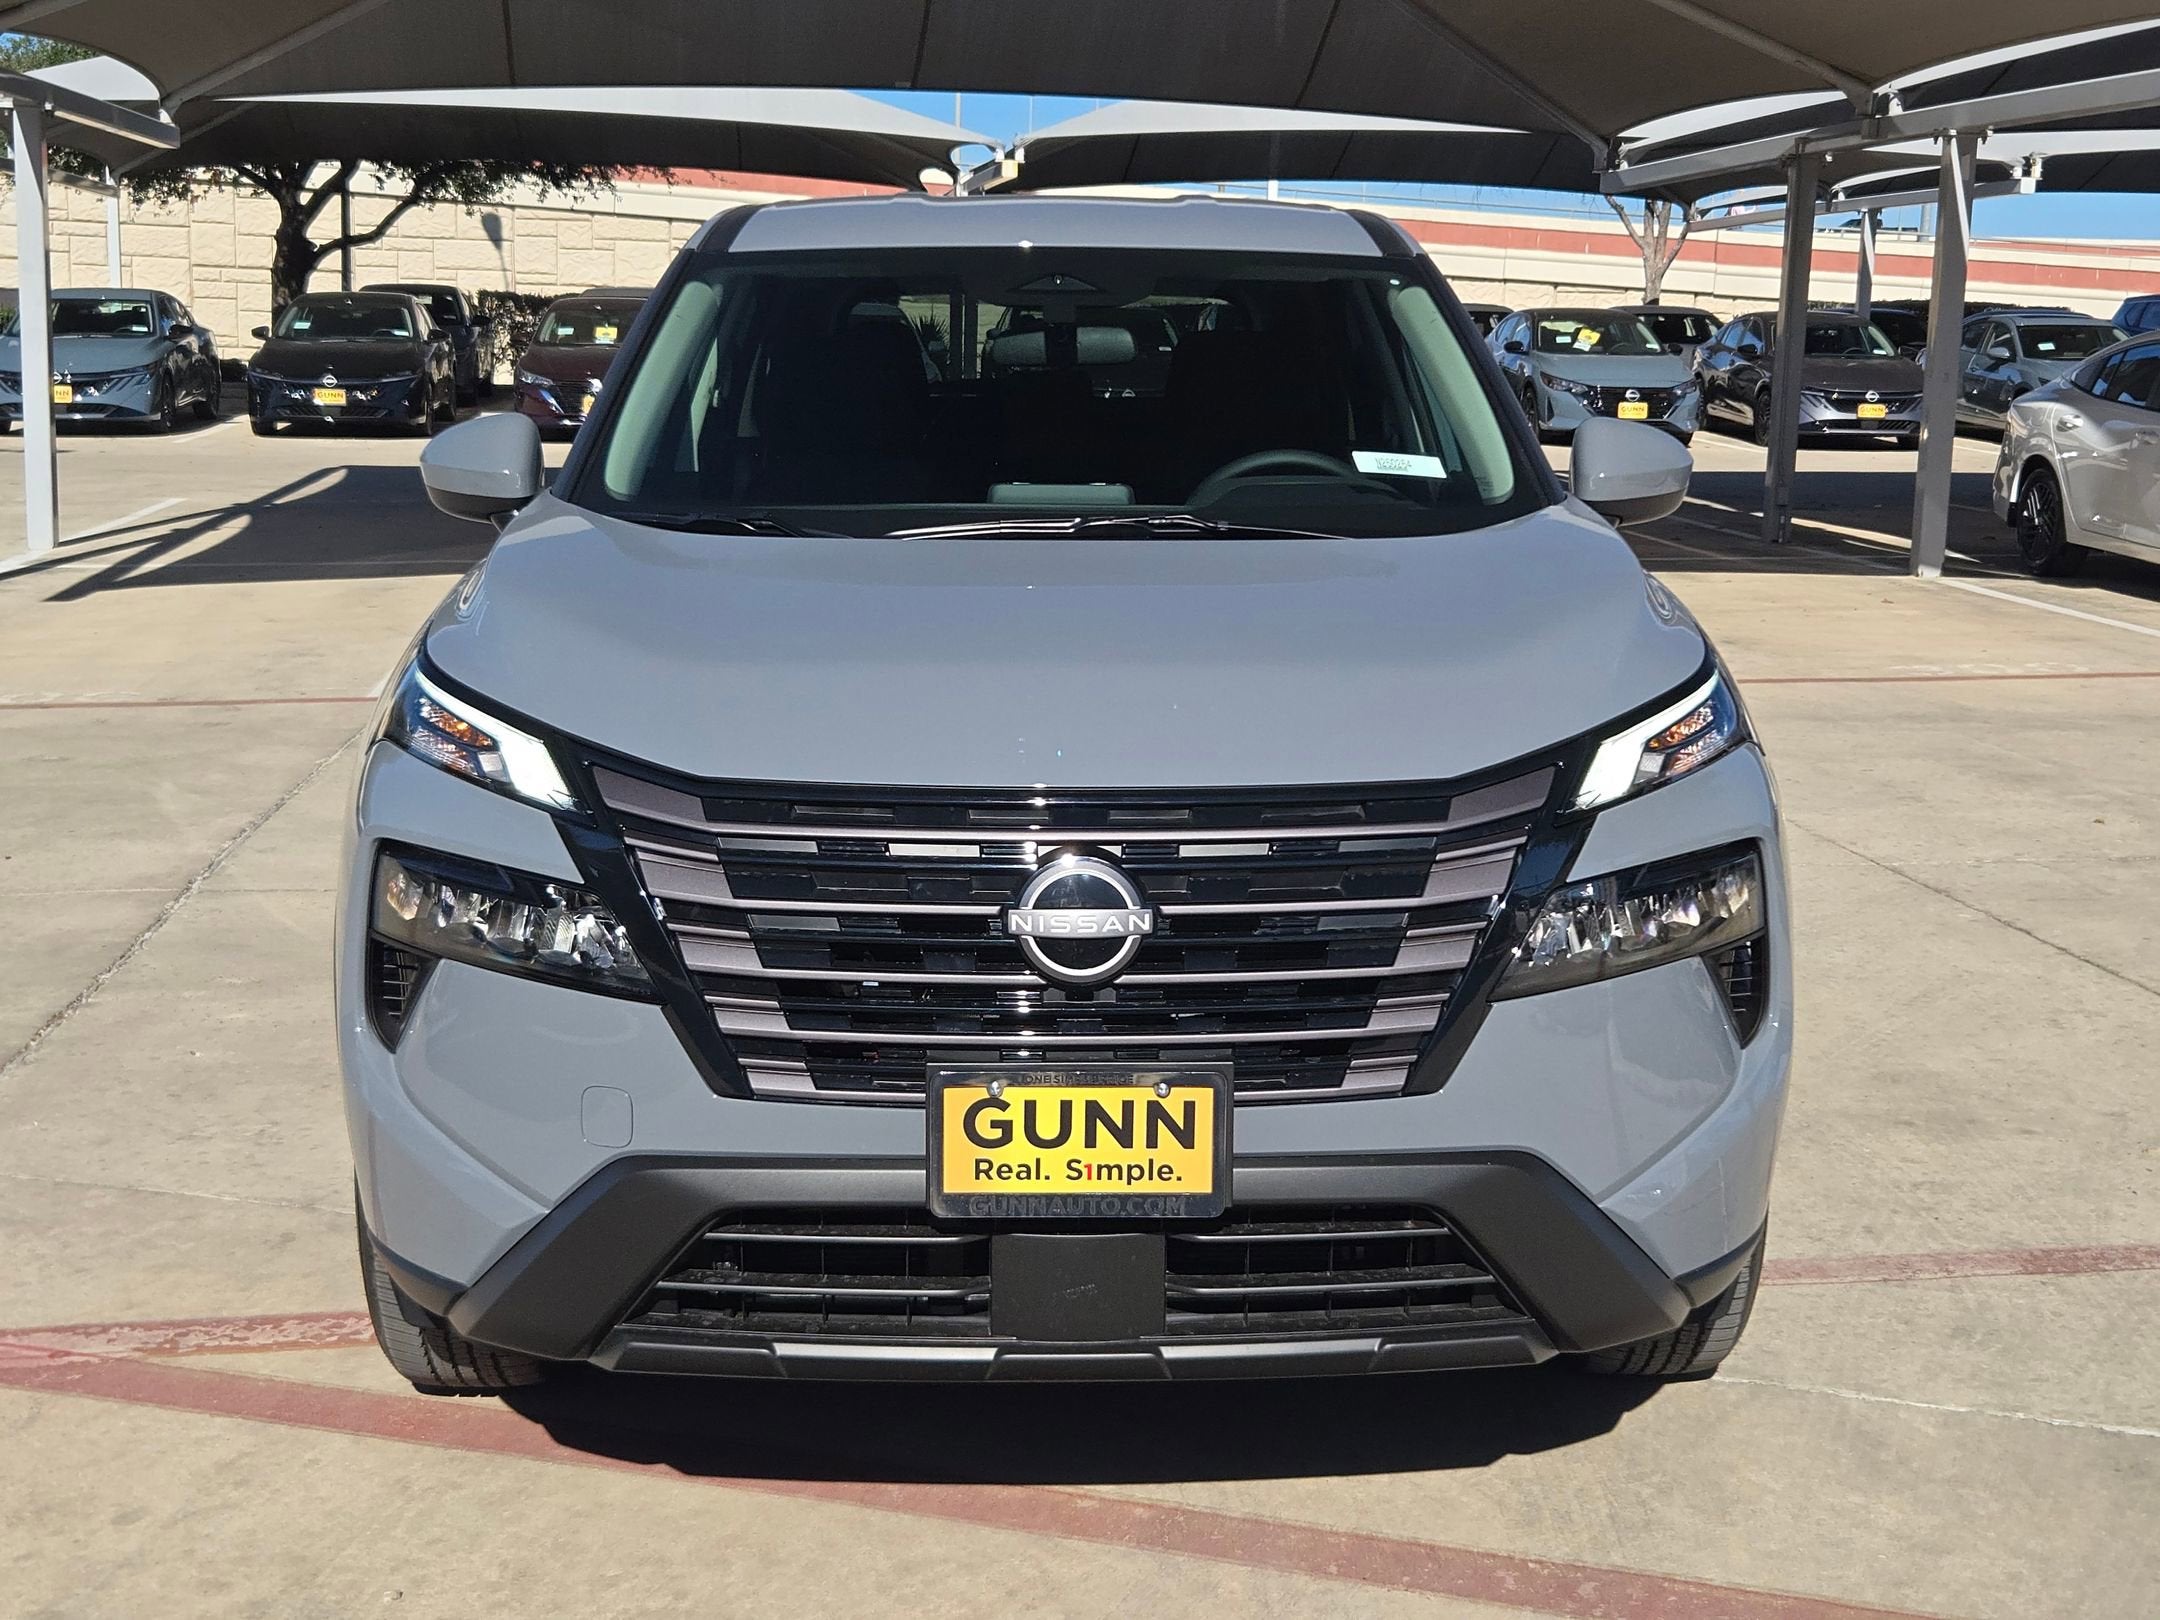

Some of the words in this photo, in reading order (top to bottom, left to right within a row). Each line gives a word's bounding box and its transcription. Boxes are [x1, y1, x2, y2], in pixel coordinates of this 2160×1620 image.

[317, 391, 344, 399] GUNN
[1011, 913, 1150, 934] NISSAN
[962, 1097, 1197, 1150] GUNN
[974, 1158, 1051, 1181] Real.
[968, 1195, 1187, 1217] GUNNAUTO.COM
